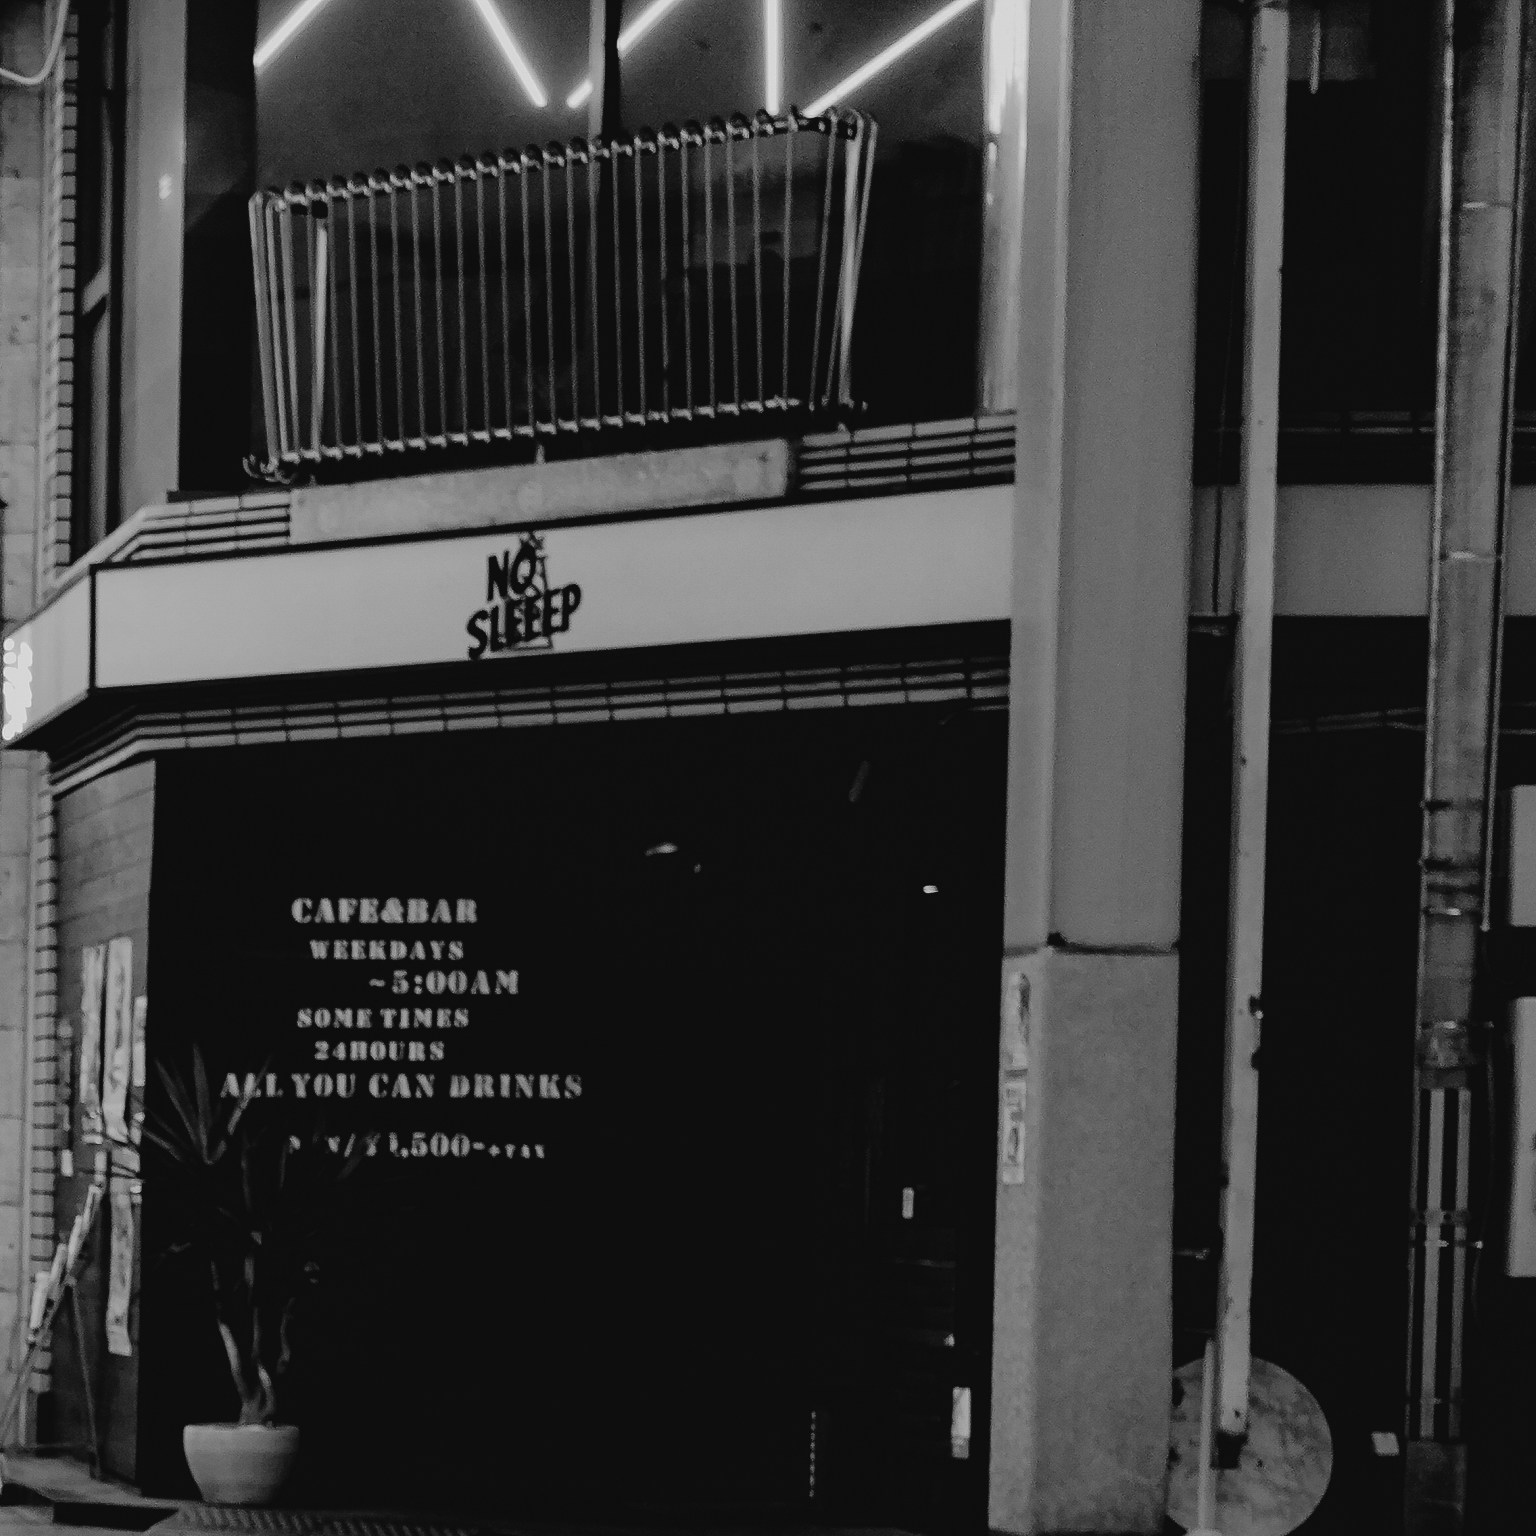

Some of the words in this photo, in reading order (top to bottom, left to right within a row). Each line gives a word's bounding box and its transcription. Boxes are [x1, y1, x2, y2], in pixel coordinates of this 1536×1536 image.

[487, 543, 536, 601] NO
[291, 897, 478, 924] CAFE&BAR
[309, 939, 464, 961] WEEKDAYS
[296, 1007, 372, 1029] SOME
[381, 1007, 470, 1029] TIMES
[314, 1040, 445, 1062] 24HOURS
[220, 1073, 283, 1098] ALL
[291, 1073, 356, 1098] YOU
[368, 1073, 435, 1098] CAN
[449, 1073, 583, 1099] DRINKS
